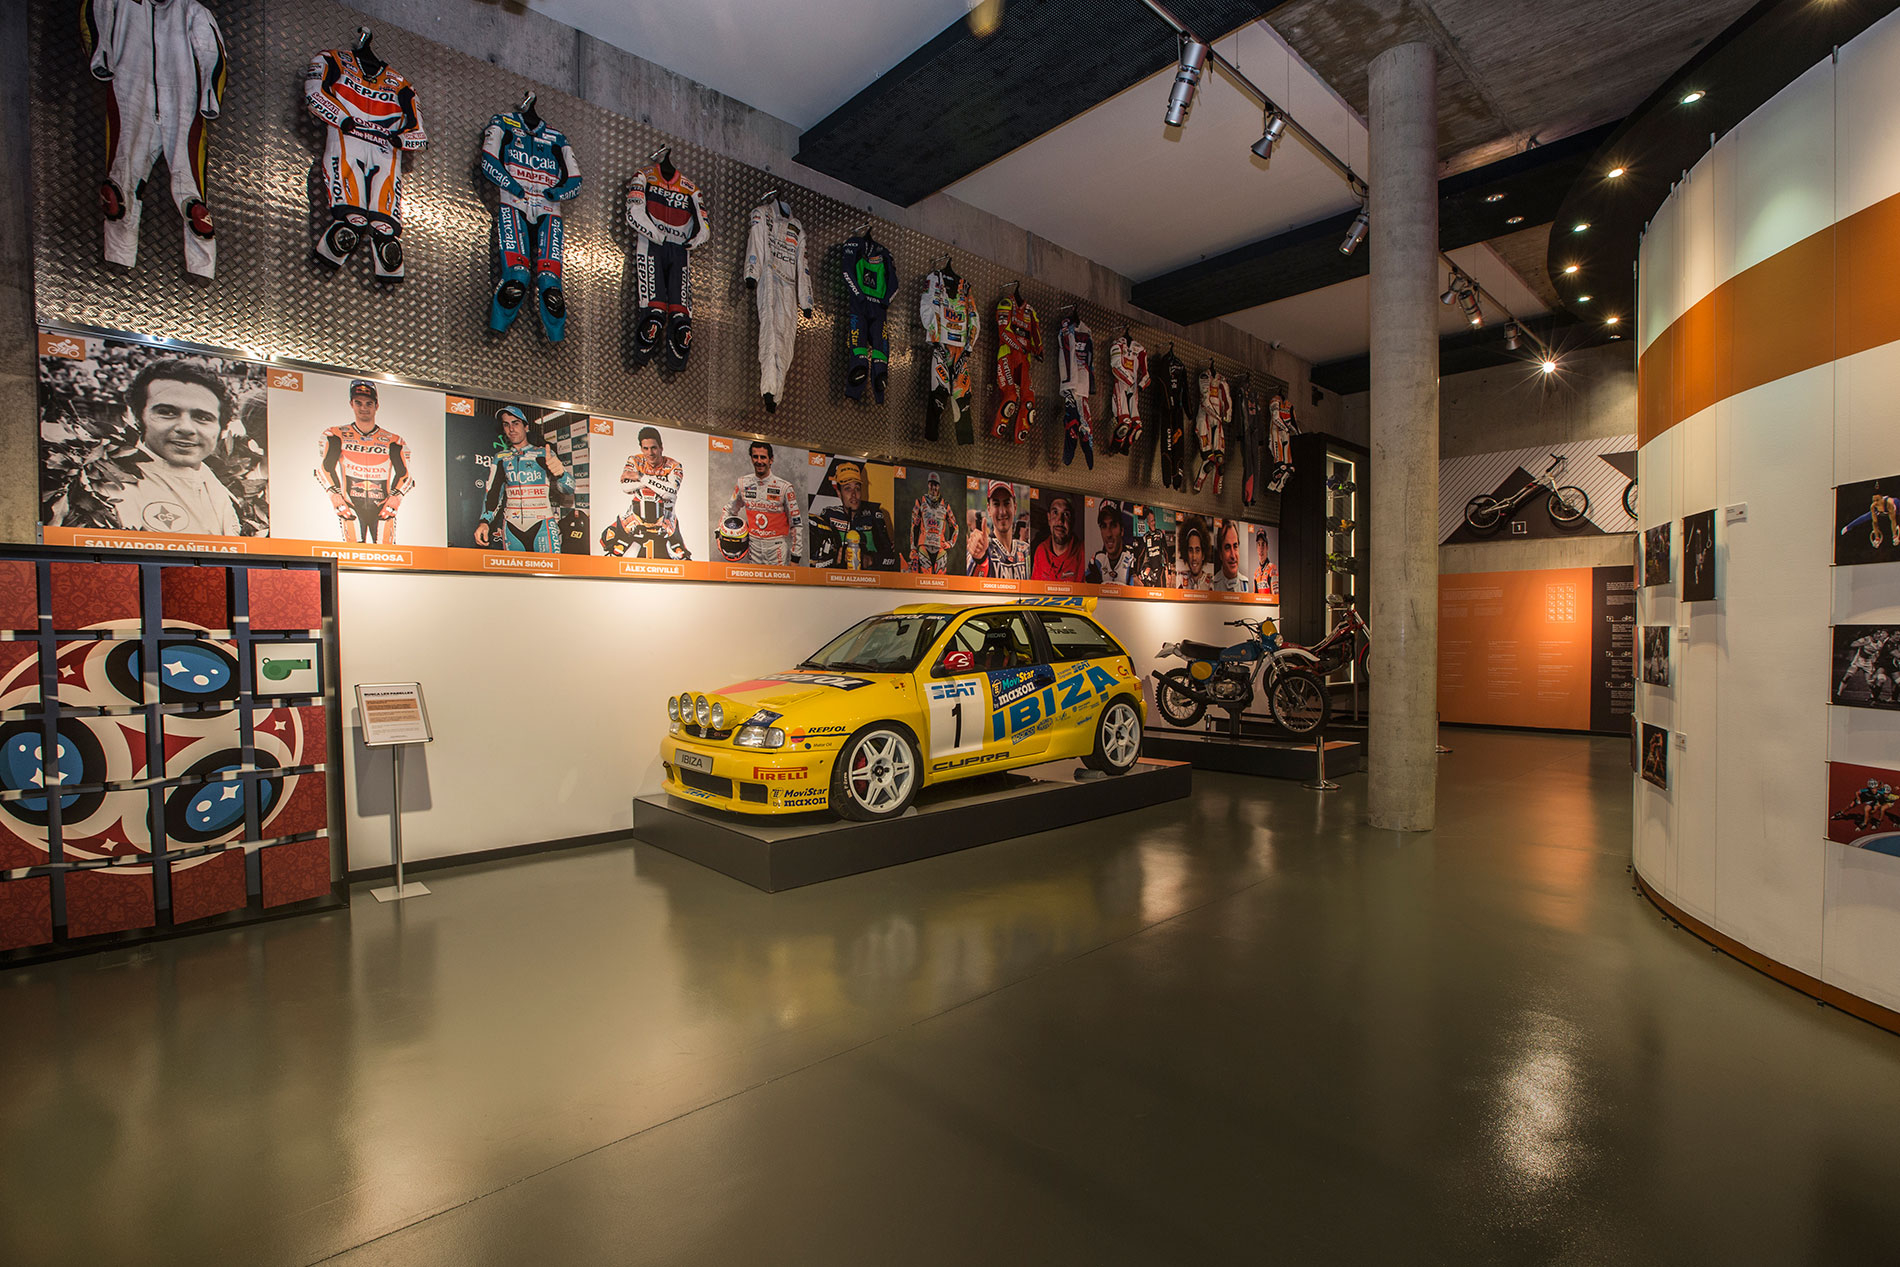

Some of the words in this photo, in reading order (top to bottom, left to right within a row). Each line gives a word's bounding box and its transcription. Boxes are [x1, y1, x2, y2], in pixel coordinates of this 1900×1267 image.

[344, 76, 397, 102] REPSOL
[306, 95, 338, 123] REPSOL
[353, 117, 392, 135] ONDA
[481, 159, 511, 187] ancaja
[517, 169, 557, 186] MAPFRE
[666, 198, 689, 209] YPF
[501, 206, 517, 250] Bancaja
[654, 223, 688, 239] ONDA
[648, 255, 656, 300] HONDA
[344, 444, 388, 455] REPSOL
[346, 463, 387, 474] HONDA
[158, 513, 175, 522] CS
[84, 540, 165, 551] SALVADOR
[167, 542, 238, 554] CAÑELLAS
[643, 540, 655, 559] 1
[321, 551, 350, 560] DANI
[352, 552, 404, 562] PEDROSA
[490, 558, 523, 567] JULIÁN
[525, 558, 553, 568] SIMÓN
[992, 562, 1026, 580] YAMAH
[1002, 669, 1034, 690] MoviStar
[931, 682, 976, 700] SEAT
[998, 681, 1035, 706] maxon
[992, 666, 1120, 742] IBIZA
[808, 725, 847, 734] REPSOL
[951, 703, 961, 748] 1
[681, 754, 703, 768] IBIZA
[932, 751, 1010, 771] CUPRA
[753, 766, 808, 780] PIRELLI
[784, 787, 827, 798] MoviStar
[784, 797, 827, 807] maxon
